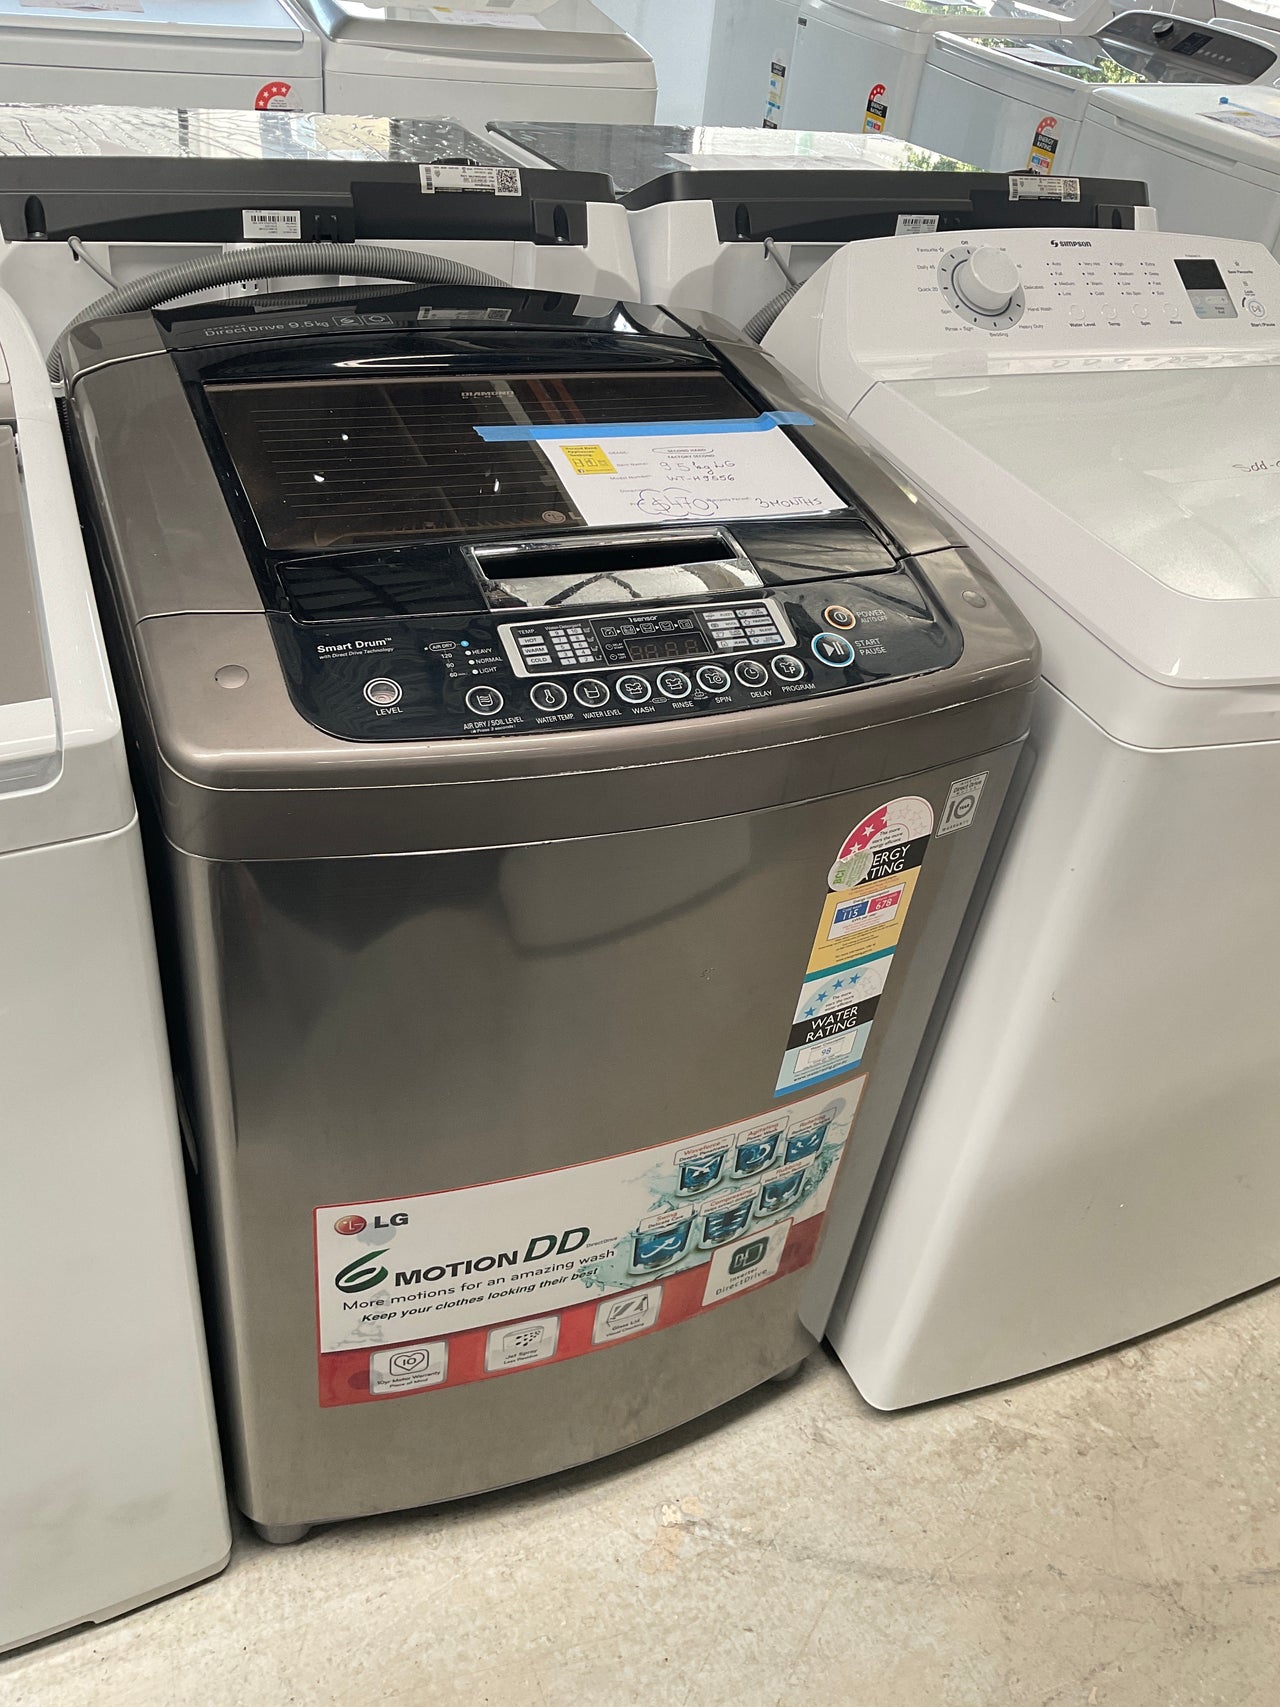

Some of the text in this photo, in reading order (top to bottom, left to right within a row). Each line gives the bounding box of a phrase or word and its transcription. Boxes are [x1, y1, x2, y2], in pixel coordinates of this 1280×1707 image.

[856, 609, 885, 618] POWER
[317, 642, 352, 653] Smart
[854, 638, 880, 647] START
[859, 647, 887, 655] PAUSE
[479, 666, 497, 674] LIGHT
[782, 683, 816, 692] PROGRAM
[715, 696, 732, 704] SPIN
[750, 690, 772, 699] DELAY
[632, 706, 655, 714] WASH
[672, 701, 694, 709] RINSE
[376, 706, 403, 716] LEVEL
[583, 708, 622, 720] WATER LEVEL
[464, 722, 474, 730] AIR
[505, 716, 524, 724] LEVEL
[536, 715, 558, 724] WATER
[873, 844, 911, 866] ERGY
[866, 860, 905, 880] TING
[876, 899, 892, 910] 678
[843, 909, 858, 920] 115
[811, 1006, 858, 1030] WATER
[805, 1017, 857, 1042] RATING
[822, 1047, 832, 1056] 98
[374, 1212, 409, 1229] LG
[395, 1250, 518, 1287] MOTION
[523, 1226, 590, 1262] DD
[343, 1250, 615, 1310] More motions for an amazing wash
[716, 1269, 767, 1295] DirectDrive
[361, 1268, 598, 1322] Keep your clothes looking their best
[403, 1358, 417, 1366] 10
